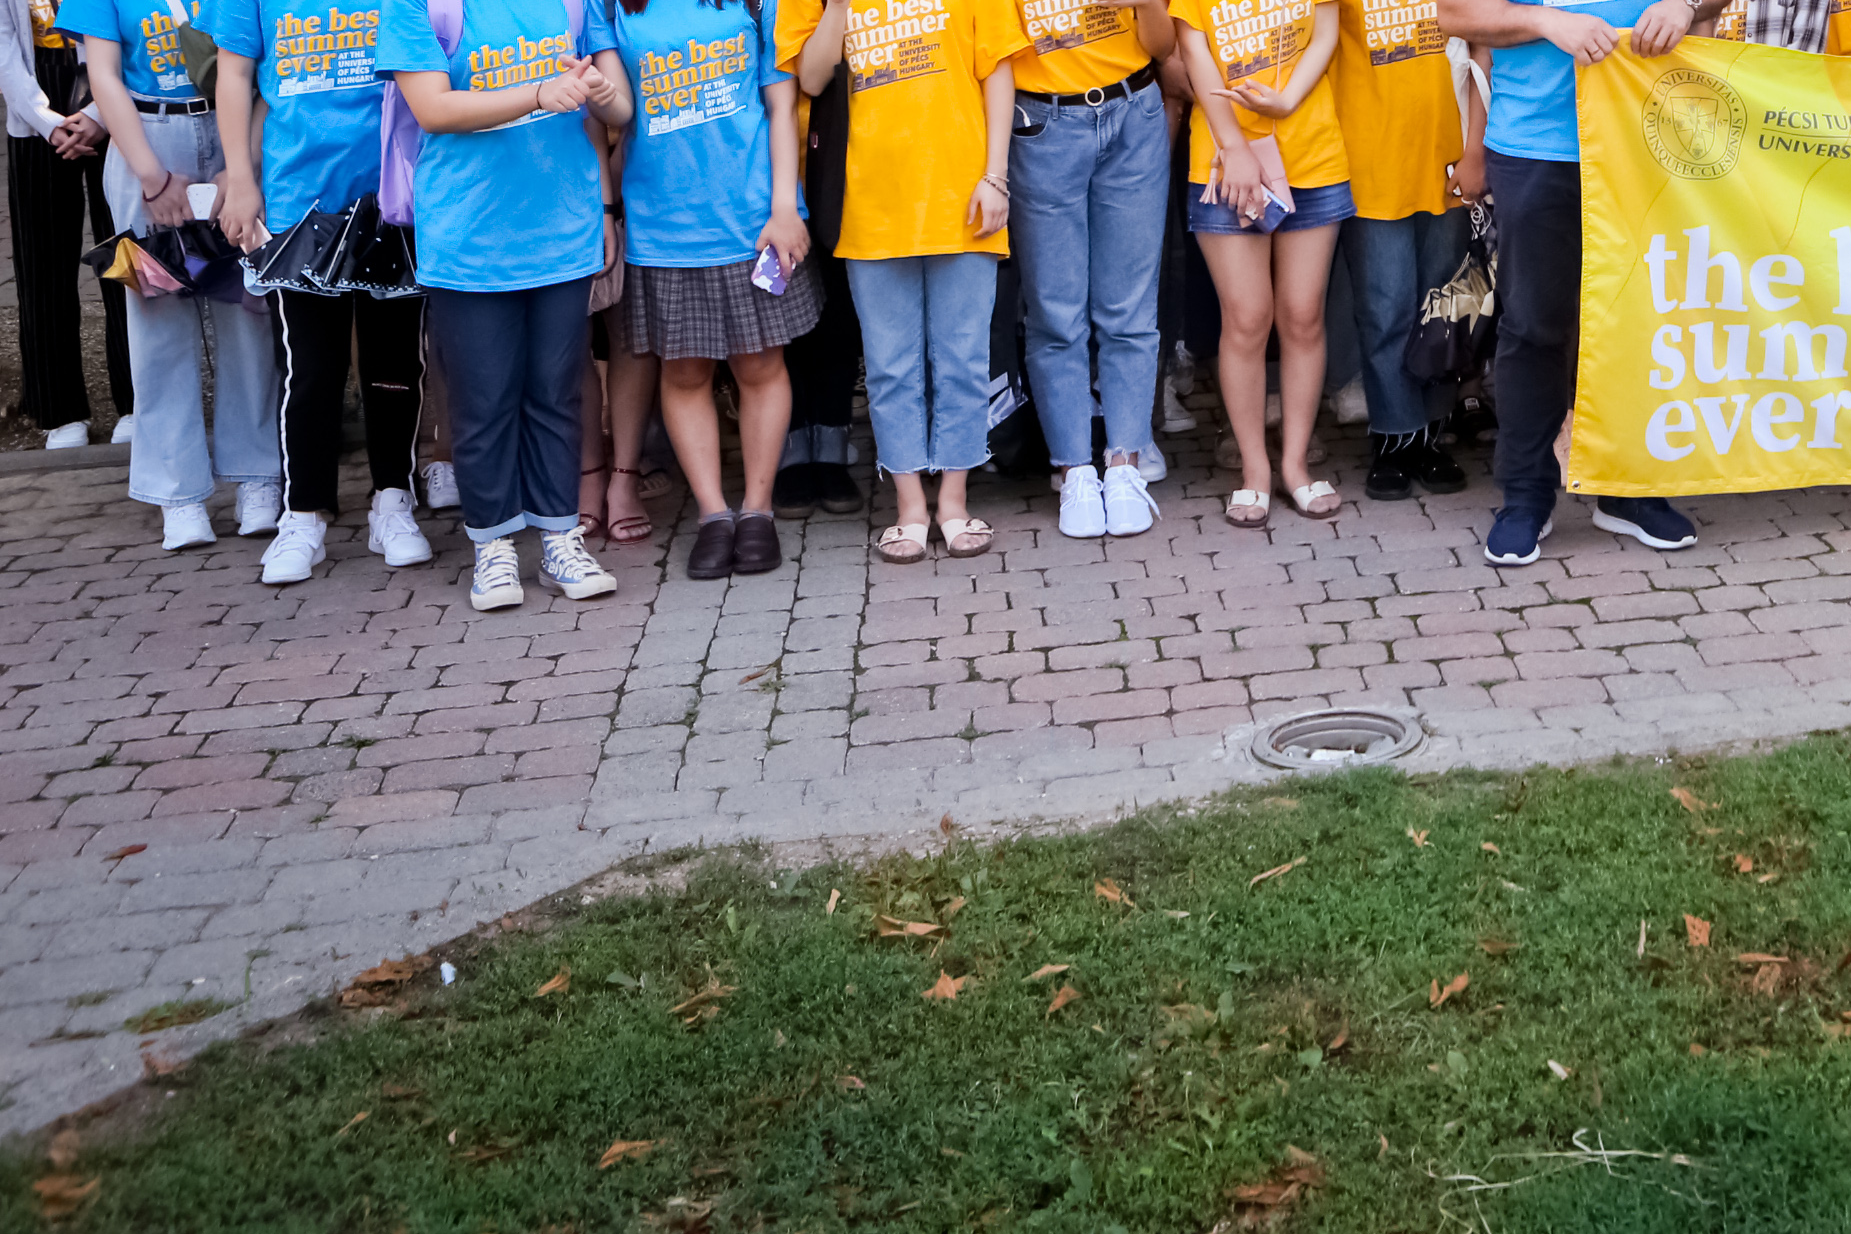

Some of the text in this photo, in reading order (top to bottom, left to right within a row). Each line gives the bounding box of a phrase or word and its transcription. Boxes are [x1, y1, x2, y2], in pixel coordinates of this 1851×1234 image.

[276, 7, 379, 38] the bes
[843, 7, 879, 34] he
[1027, 9, 1083, 37] ever
[1210, 0, 1253, 26] the
[1215, 0, 1311, 46] summer
[1364, 1, 1438, 30] summ
[275, 29, 377, 58] summe
[844, 12, 950, 54] summer
[908, 38, 923, 46] THE
[1087, 24, 1121, 38] HUNGARY
[1366, 23, 1416, 48] ever
[338, 50, 366, 60] AT THE
[468, 30, 574, 73] the best
[639, 32, 746, 79] the best
[848, 42, 898, 73] ever
[899, 43, 941, 57] UNIVERSITY
[900, 54, 929, 66] OF PÉCS
[1219, 32, 1269, 62] ever
[277, 53, 337, 76] ever
[337, 65, 370, 77] OF PÉCS
[641, 53, 749, 97] summer
[900, 61, 935, 75] HUNGARY
[645, 84, 702, 115] ever
[703, 83, 713, 92] AT
[1656, 72, 1739, 105] UNIVERSITAS
[705, 99, 716, 107] OF
[1763, 106, 1819, 130] PÉCSI
[1644, 224, 1805, 314] the
